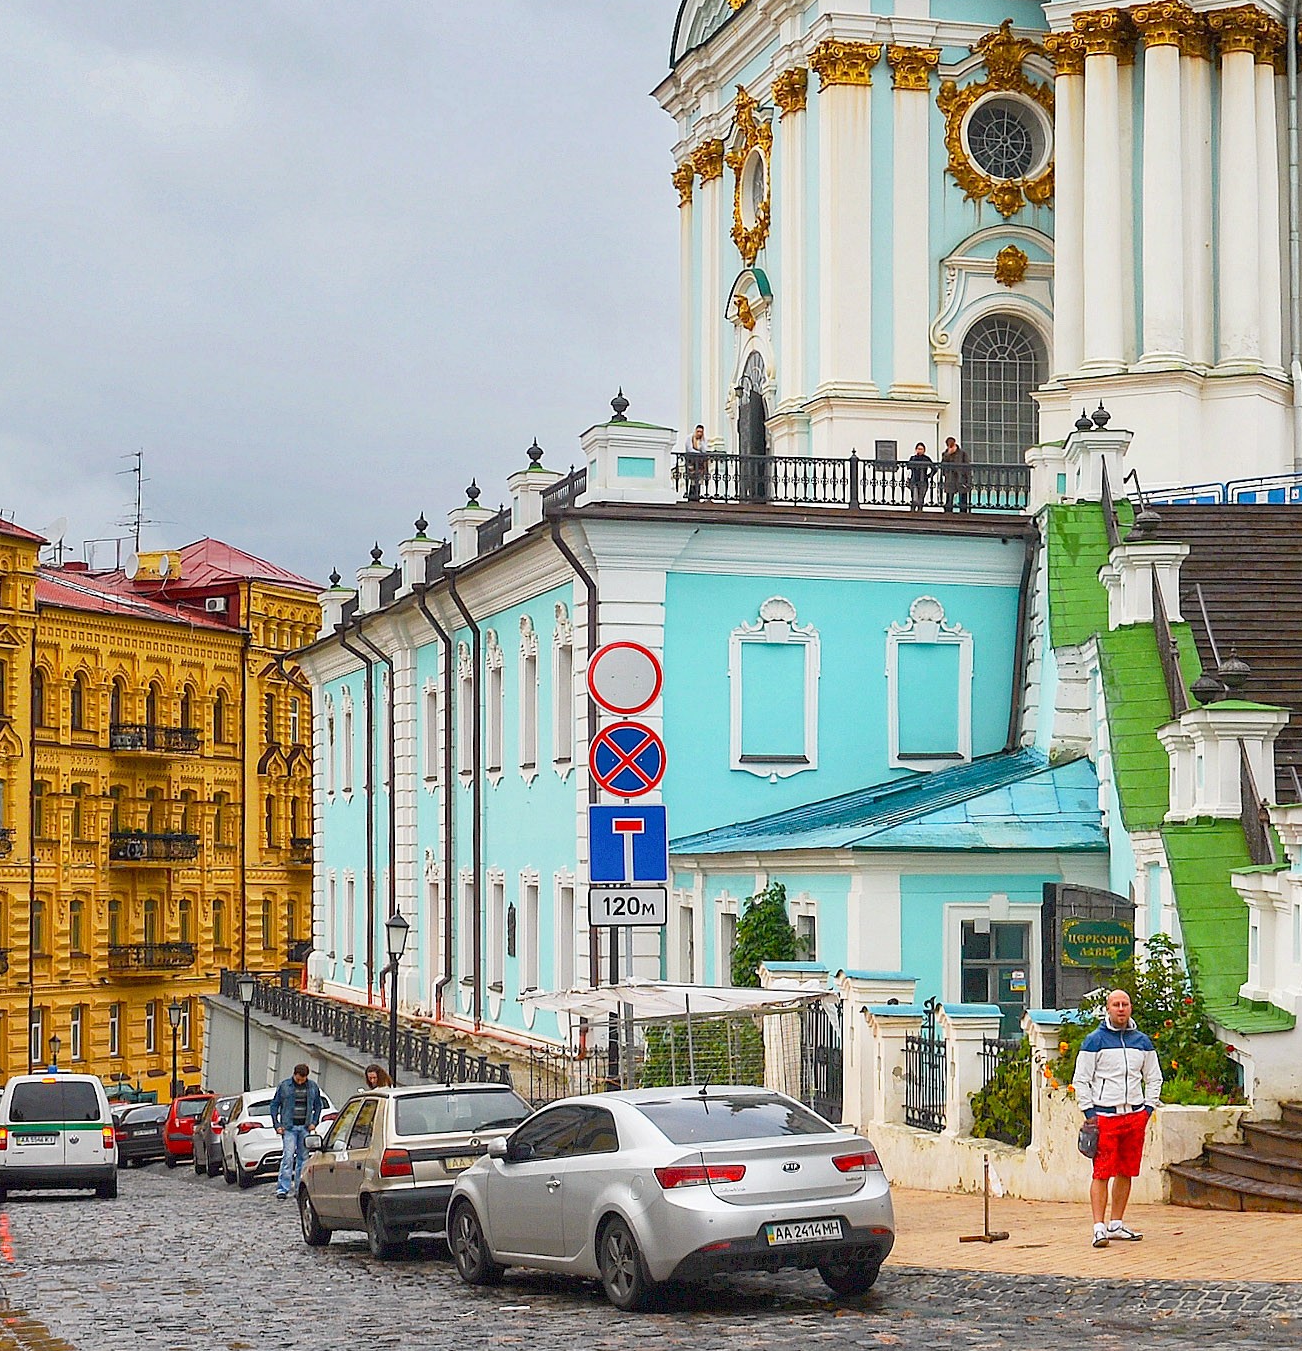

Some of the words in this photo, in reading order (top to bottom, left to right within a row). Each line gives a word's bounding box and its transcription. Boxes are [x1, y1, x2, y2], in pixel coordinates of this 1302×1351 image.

[1068, 934, 1130, 945] ЦЕРКОВНА
[775, 1226, 792, 1240] AA
[794, 1224, 822, 1239] 2414
[822, 1221, 840, 1236] MH
